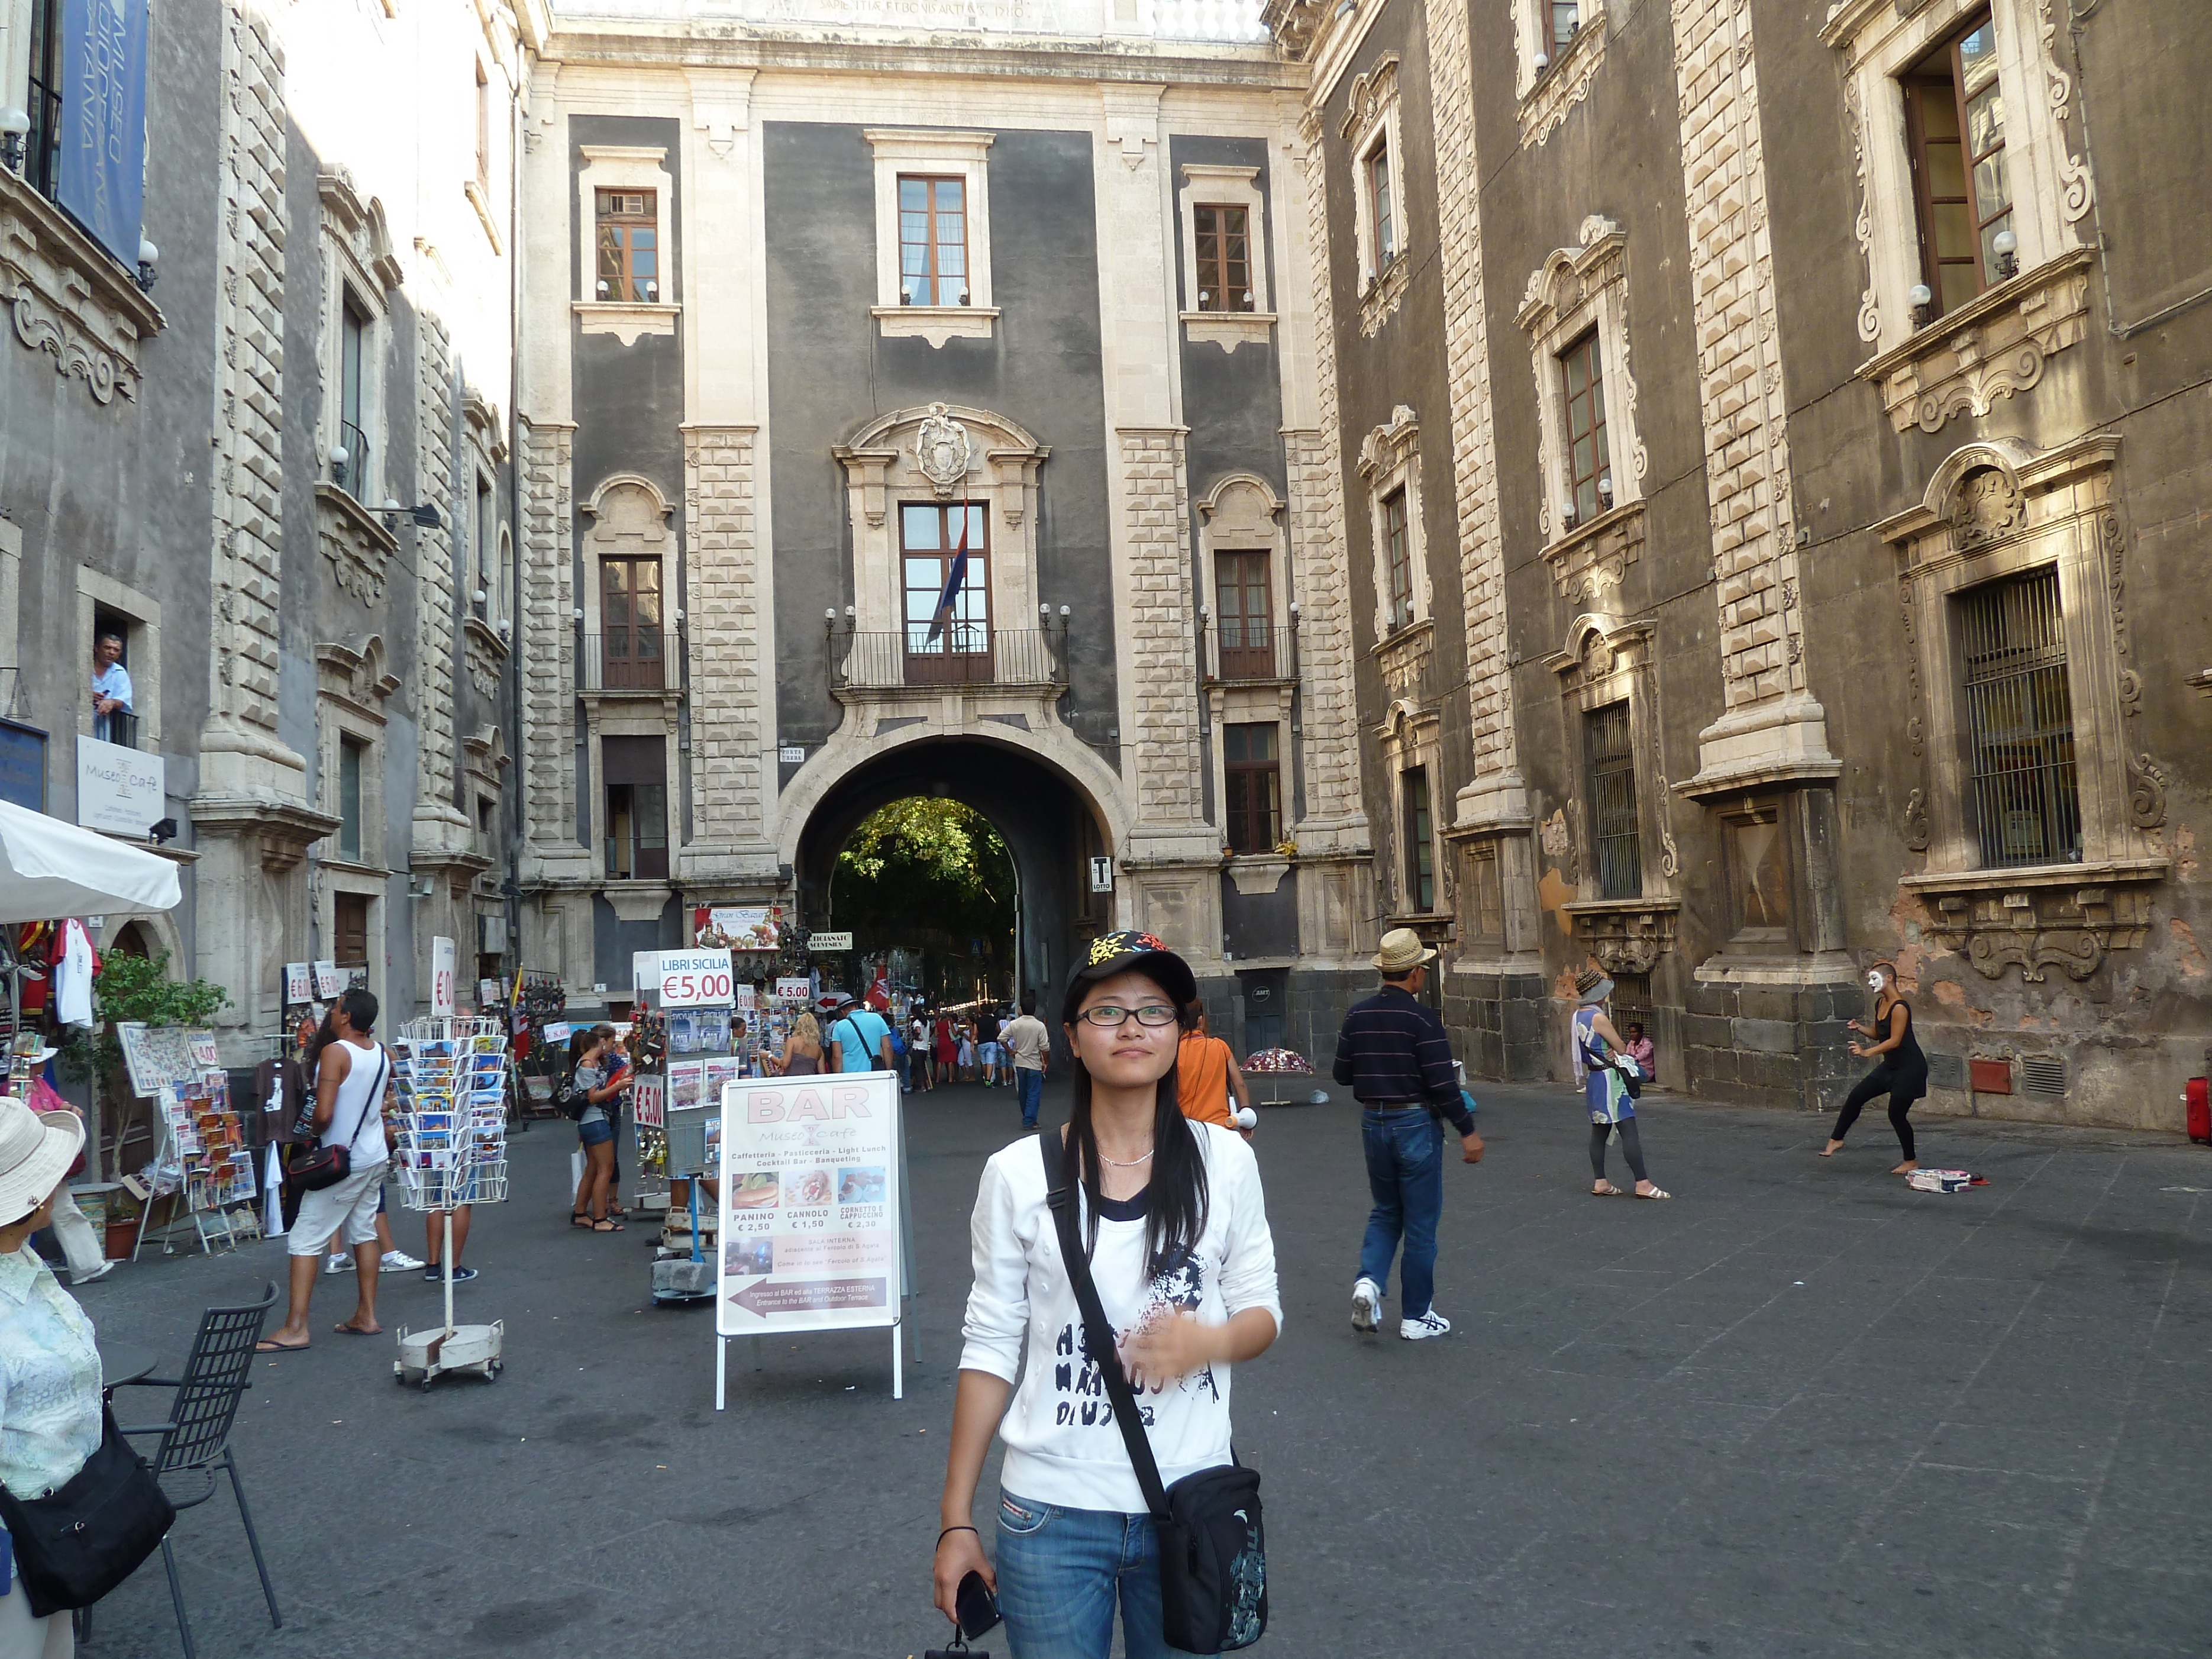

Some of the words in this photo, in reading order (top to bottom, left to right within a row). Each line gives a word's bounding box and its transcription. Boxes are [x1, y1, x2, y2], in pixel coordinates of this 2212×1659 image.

[109, 18, 127, 164] MUSEO
[86, 764, 121, 782] Museo
[711, 911, 734, 921] Gran
[662, 959, 690, 971] LIBRI
[692, 958, 729, 970] SICILIA
[787, 987, 808, 997] 5.00
[636, 1085, 642, 1122] €
[645, 1087, 662, 1125] 5.00
[747, 1086, 873, 1124] BAR
[759, 1132, 805, 1142] Museo
[731, 1151, 776, 1160] Caffetteria
[734, 1213, 774, 1221] PANINO
[787, 1209, 828, 1218] CANNOLO
[840, 1212, 883, 1220] CAPPUCCINO
[748, 1223, 770, 1232] 2,50
[802, 1220, 824, 1229] 1,50
[813, 1286, 845, 1295] TERRAZZA
